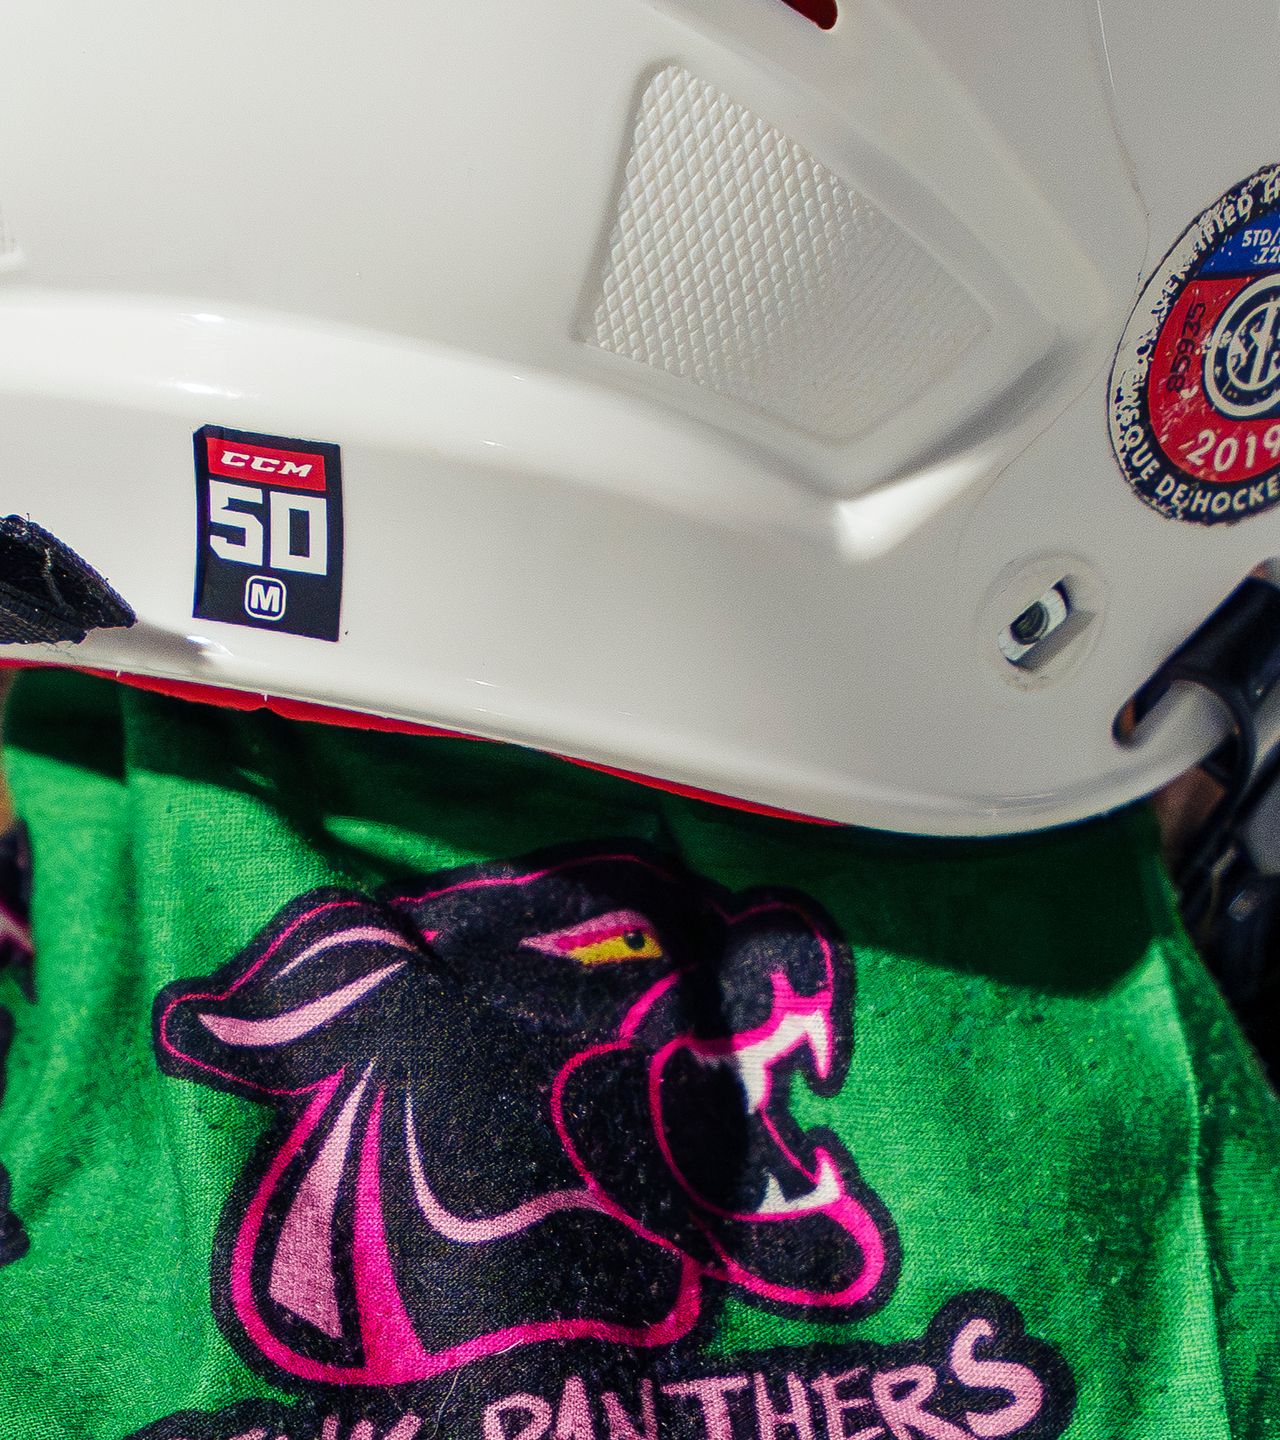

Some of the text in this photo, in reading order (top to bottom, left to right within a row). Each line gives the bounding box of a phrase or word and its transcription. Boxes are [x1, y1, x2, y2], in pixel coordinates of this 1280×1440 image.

[220, 449, 313, 478] CCM
[208, 478, 329, 576] 50
[250, 582, 281, 613] M
